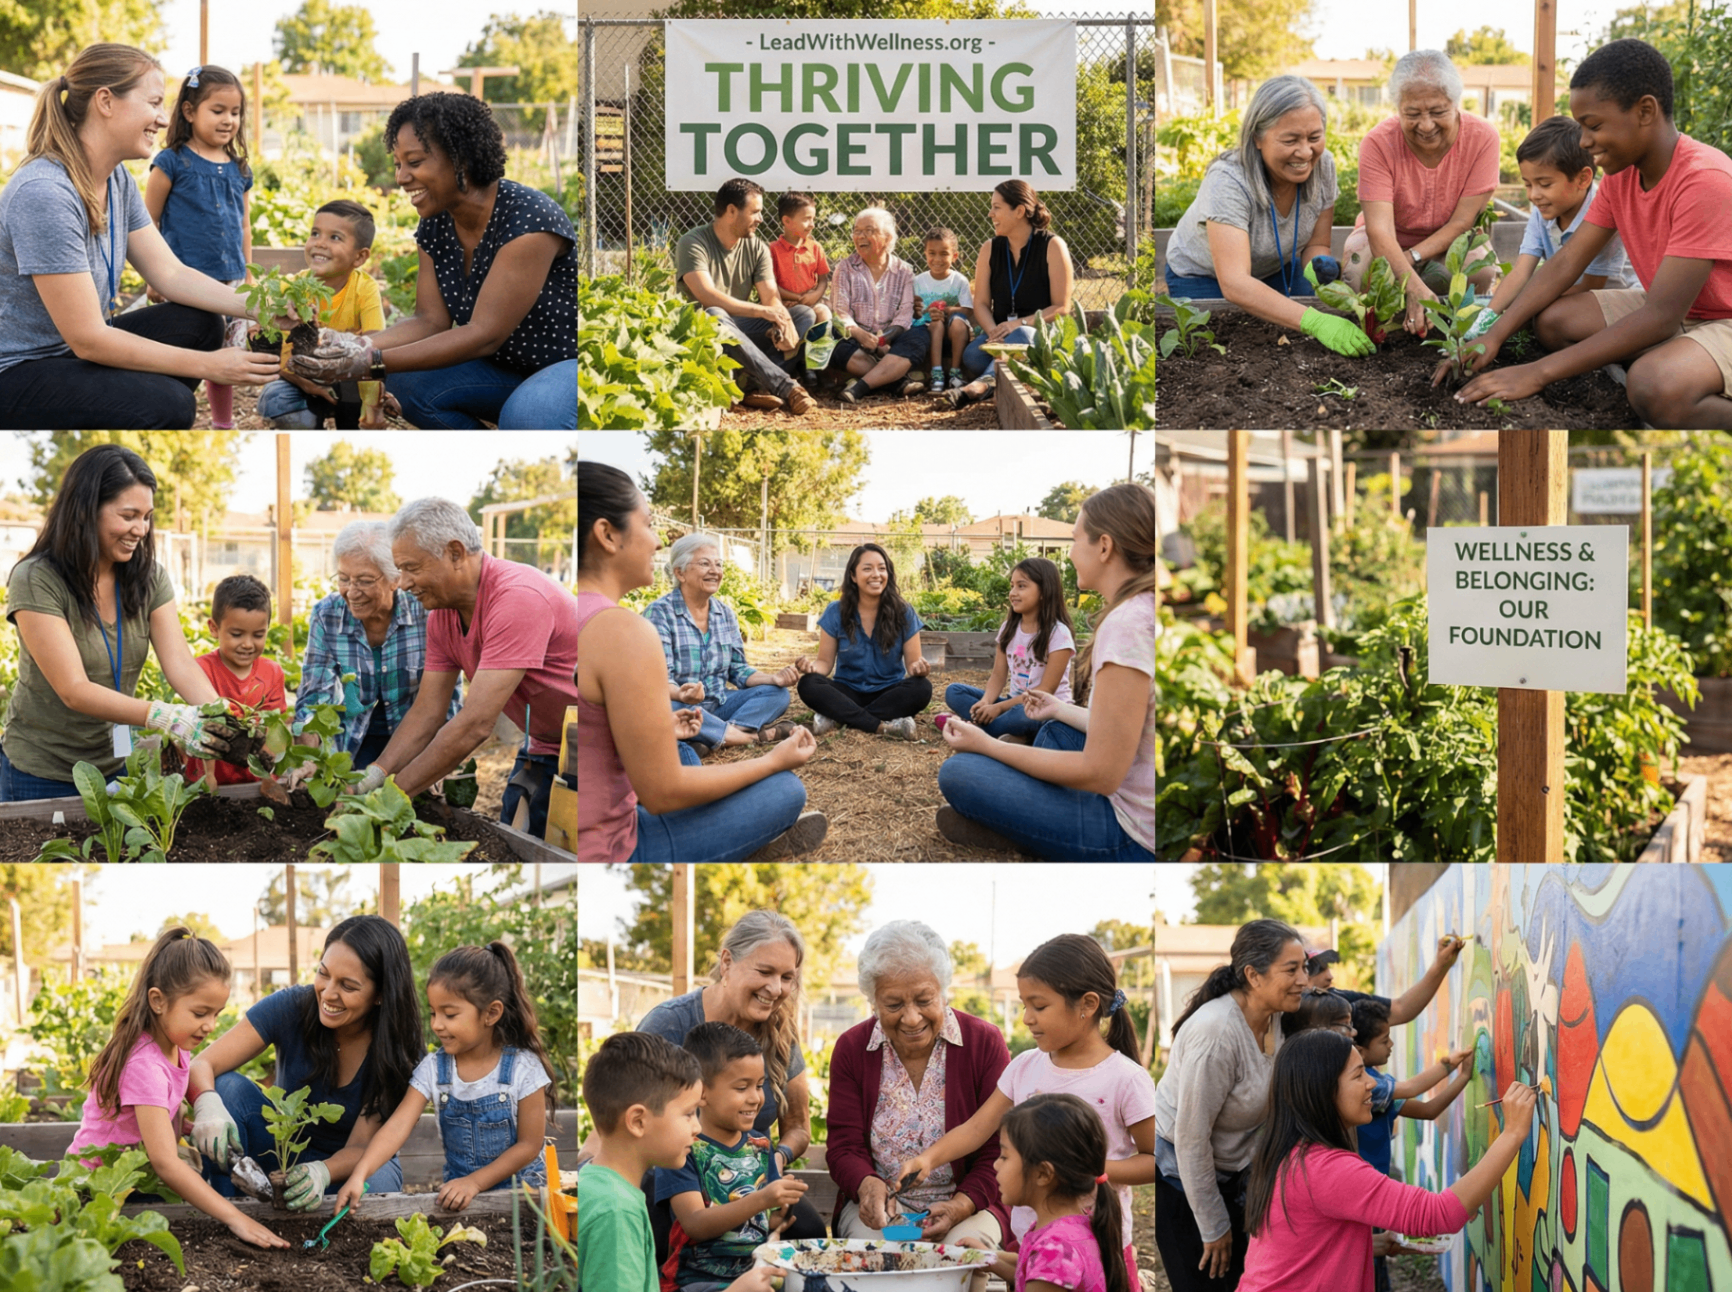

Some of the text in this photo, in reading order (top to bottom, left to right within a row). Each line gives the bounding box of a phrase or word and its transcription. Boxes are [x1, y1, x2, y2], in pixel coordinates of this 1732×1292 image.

[760, 33, 982, 54] LeadWithWellness.org
[705, 62, 1035, 113] THRIVING
[680, 123, 1062, 176] TOGETHER
[1454, 542, 1595, 562] WELLNESS &
[1455, 570, 1595, 591] BELONGING:
[1499, 600, 1549, 619] OUR
[1449, 626, 1601, 650] FOUNDATION
